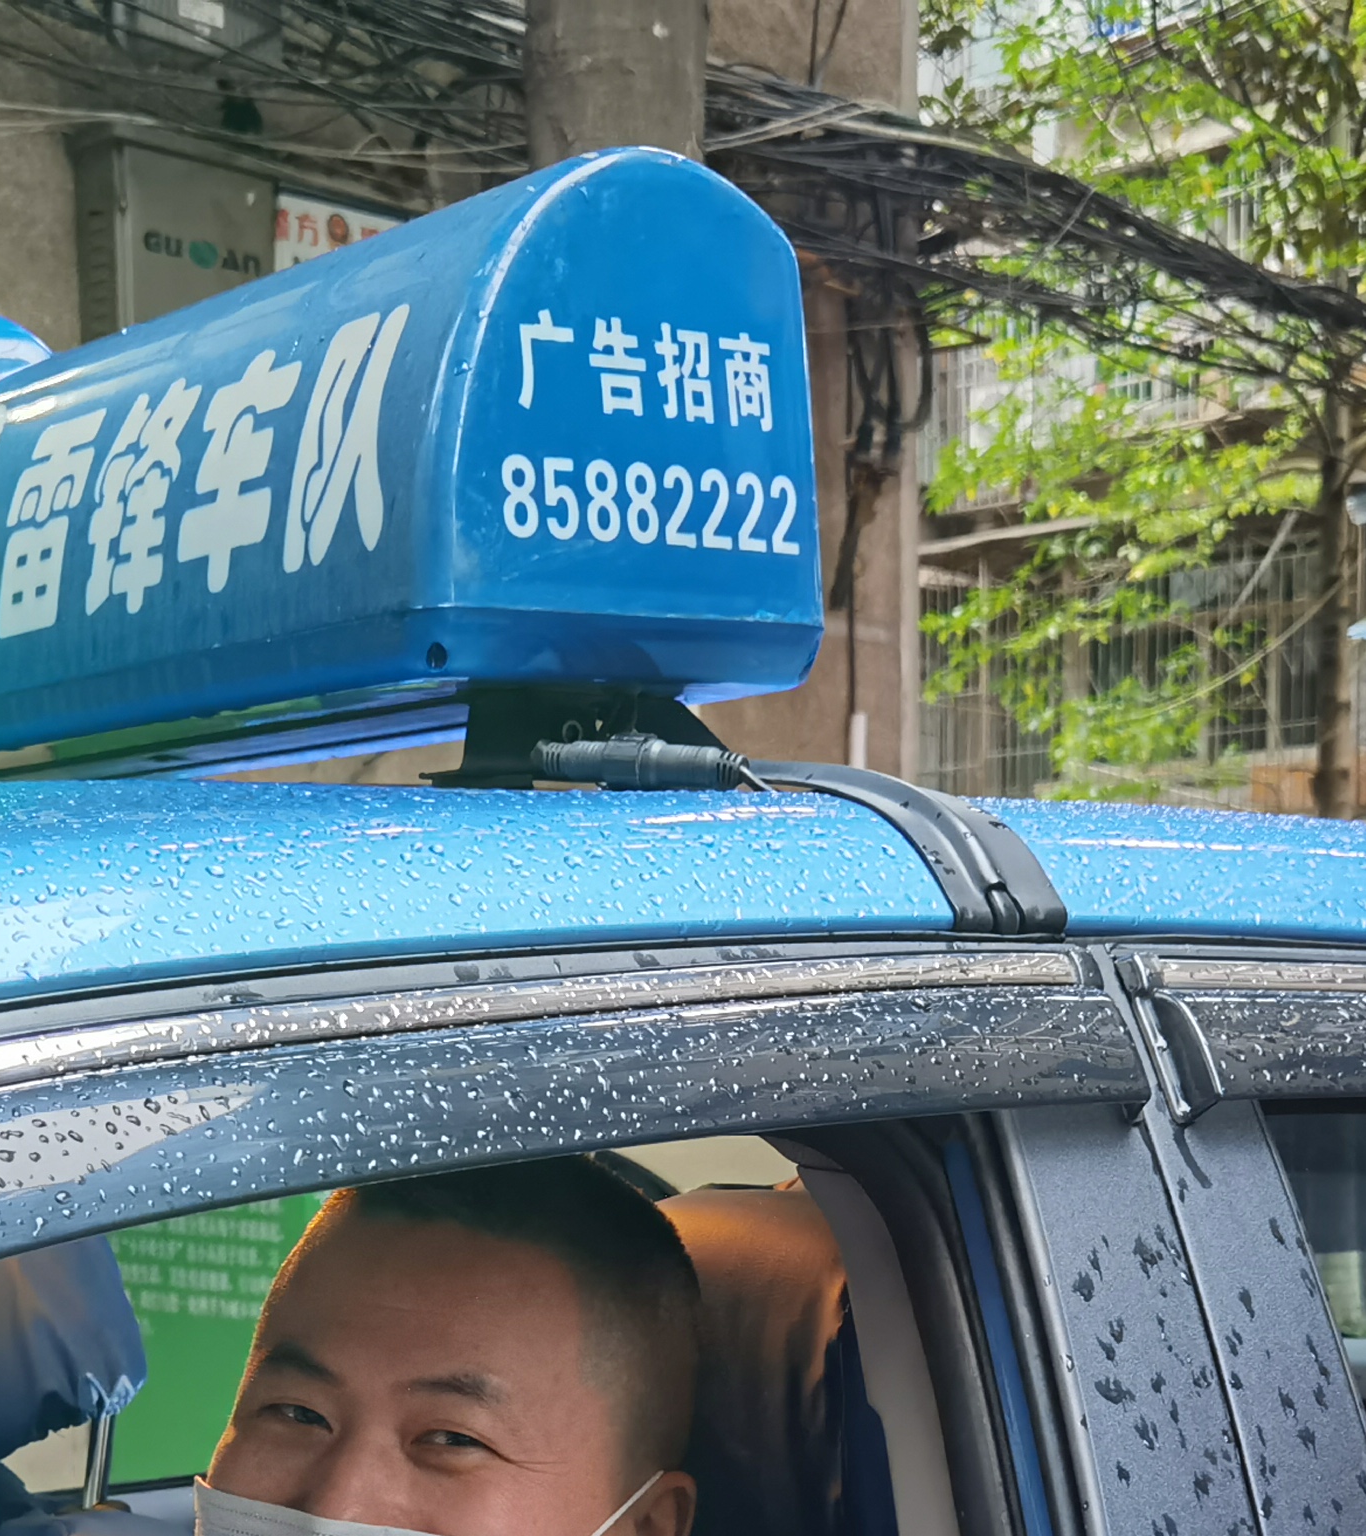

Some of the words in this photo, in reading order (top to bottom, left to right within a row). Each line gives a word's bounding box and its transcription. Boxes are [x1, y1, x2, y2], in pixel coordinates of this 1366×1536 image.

[518, 309, 773, 432] 广告招商
[502, 453, 801, 556] 85882222
